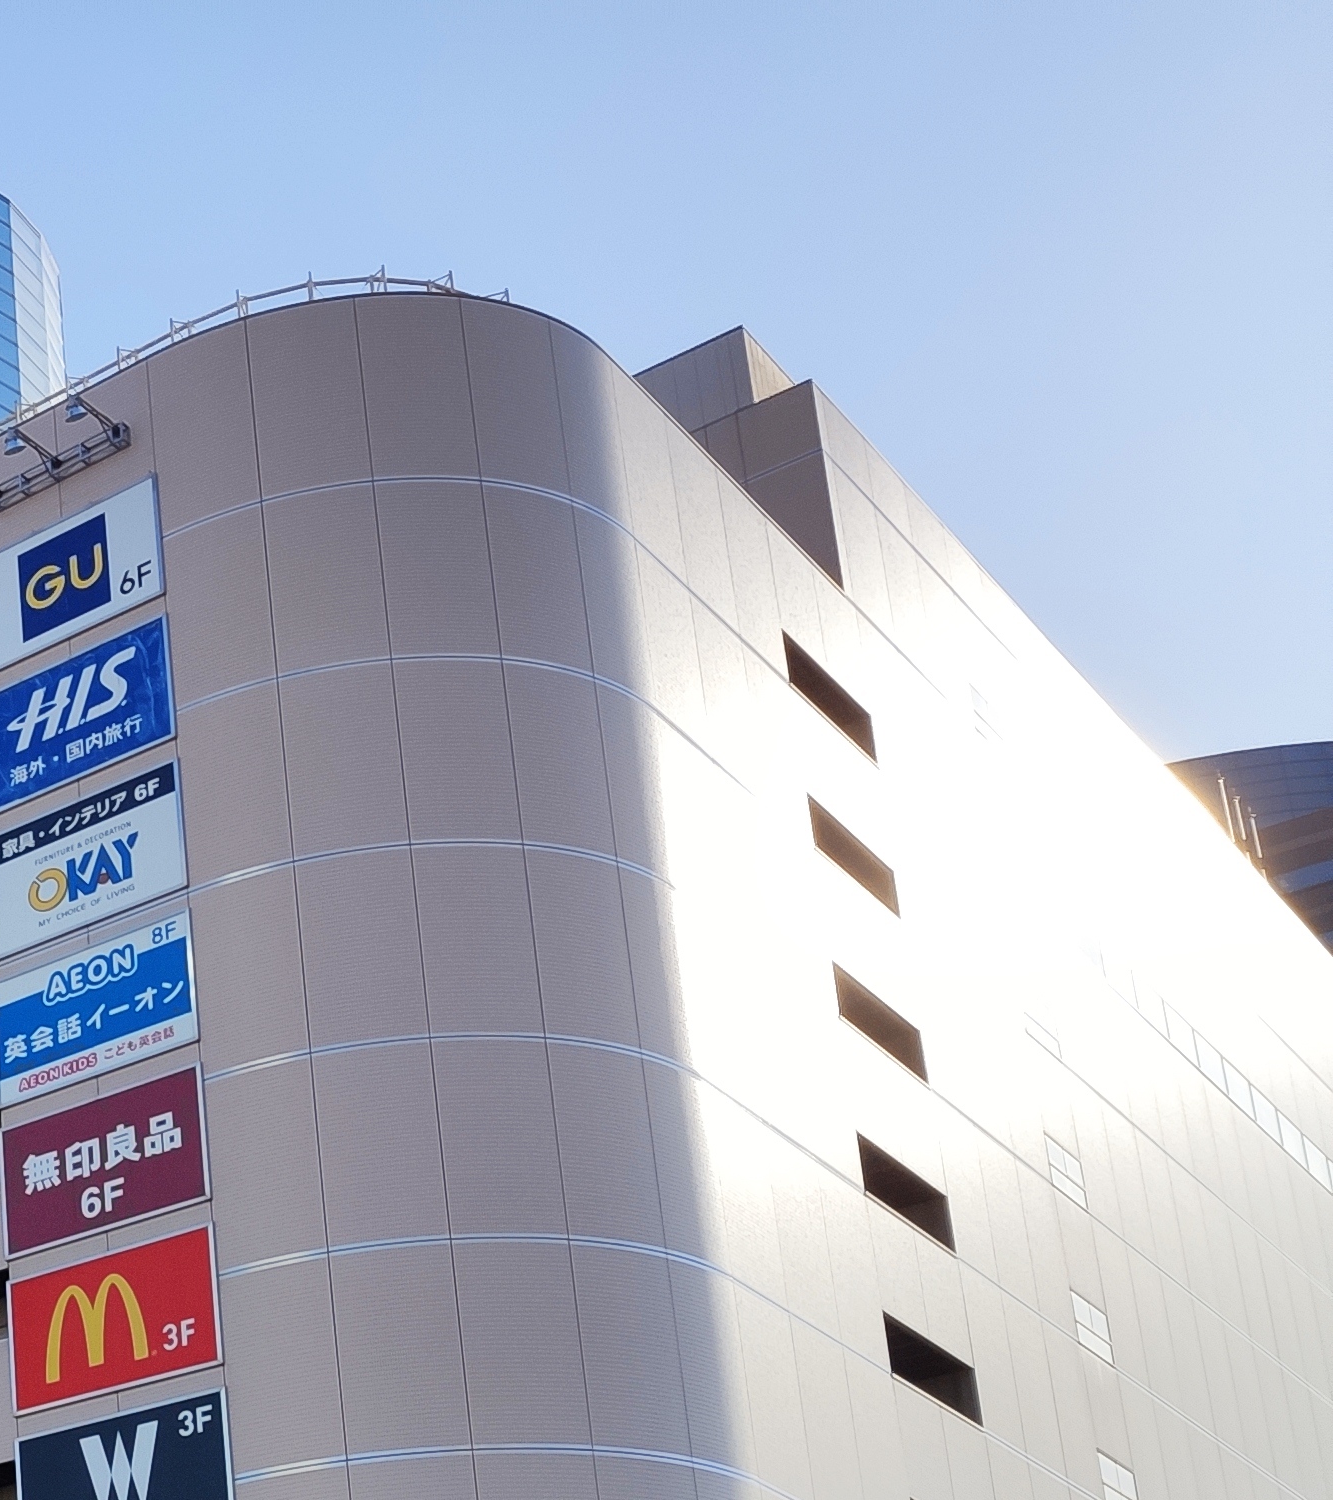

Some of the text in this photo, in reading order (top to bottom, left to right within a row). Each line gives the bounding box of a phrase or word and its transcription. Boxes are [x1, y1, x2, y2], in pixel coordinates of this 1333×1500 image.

[25, 542, 104, 610] GU
[119, 560, 152, 595] 6F
[9, 714, 142, 787] 海外・国内旅行
[1, 777, 161, 860] 家具・インテリア 6F
[35, 845, 74, 866] FURNITURE
[85, 821, 132, 845] DECORATION
[28, 831, 139, 912] OKAY
[38, 884, 136, 928] MY CHOICE OF LIVING
[151, 921, 178, 945] 8F
[46, 946, 134, 1001] AEON
[104, 1025, 175, 1060] こども英会話
[19, 1053, 97, 1092] AEON KIDS
[22, 1111, 183, 1195] 無印良品
[81, 1177, 125, 1219] 6F
[162, 1317, 195, 1351] 3F
[178, 1404, 213, 1437] 3F
